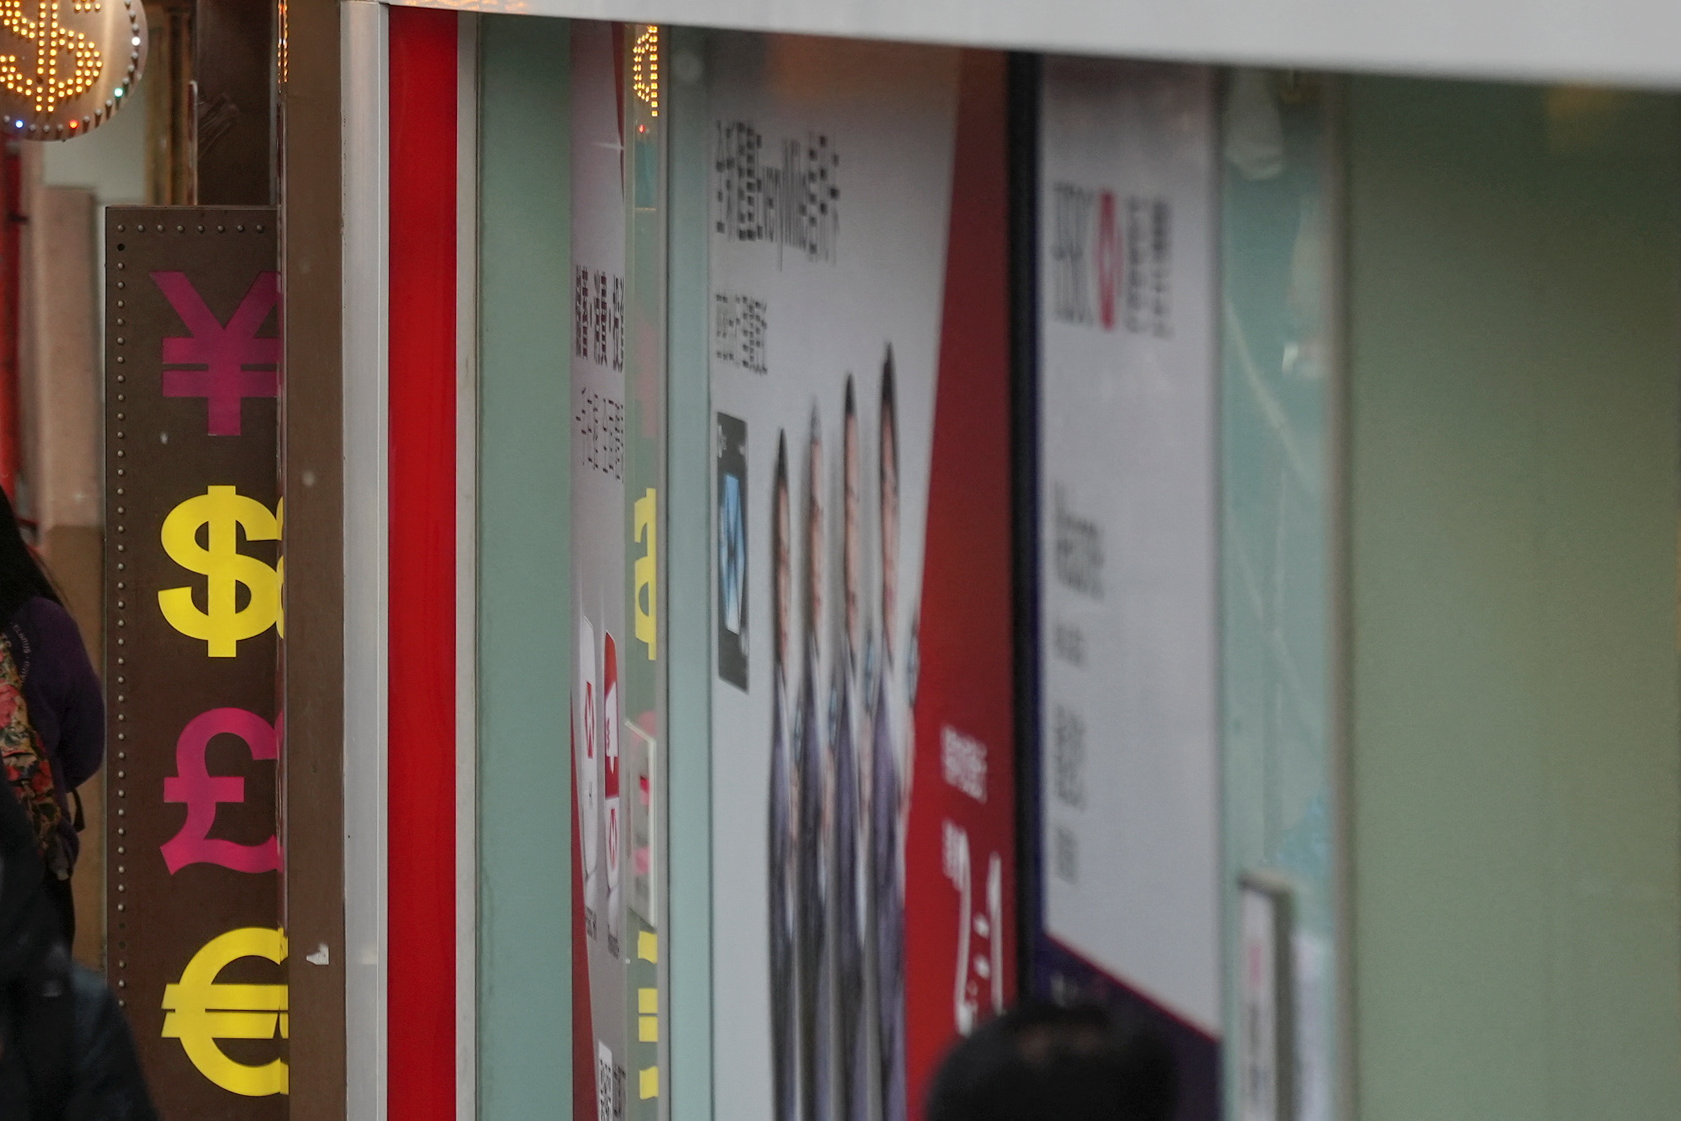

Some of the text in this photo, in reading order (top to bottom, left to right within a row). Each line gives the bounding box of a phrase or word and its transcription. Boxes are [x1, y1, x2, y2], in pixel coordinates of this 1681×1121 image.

[157, 485, 285, 658] $
[160, 706, 282, 876] £
[161, 926, 290, 1098] €
